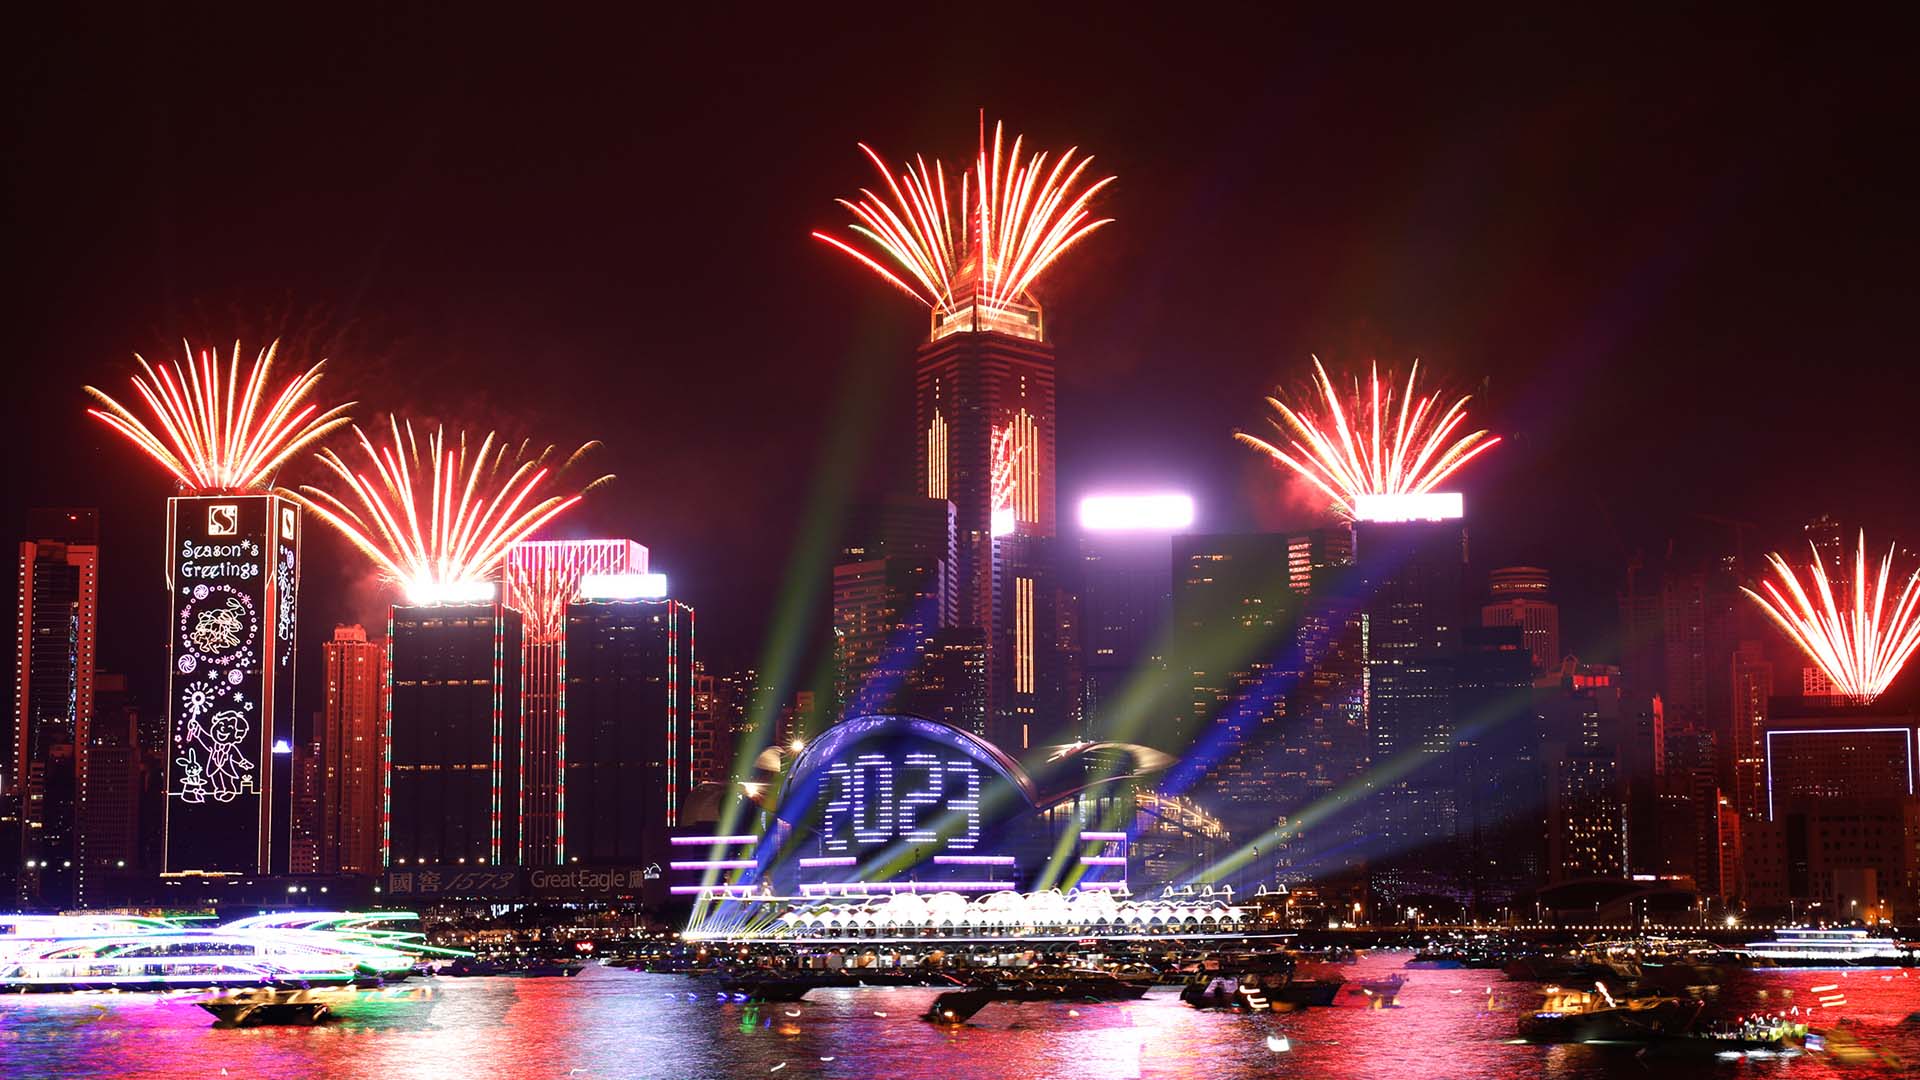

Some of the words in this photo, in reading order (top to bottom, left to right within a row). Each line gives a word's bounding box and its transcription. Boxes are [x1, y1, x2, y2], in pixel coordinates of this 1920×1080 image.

[181, 560, 259, 580] Greetings
[821, 754, 980, 850] 2023
[530, 869, 577, 888] Great
[579, 869, 625, 892] Eagle
